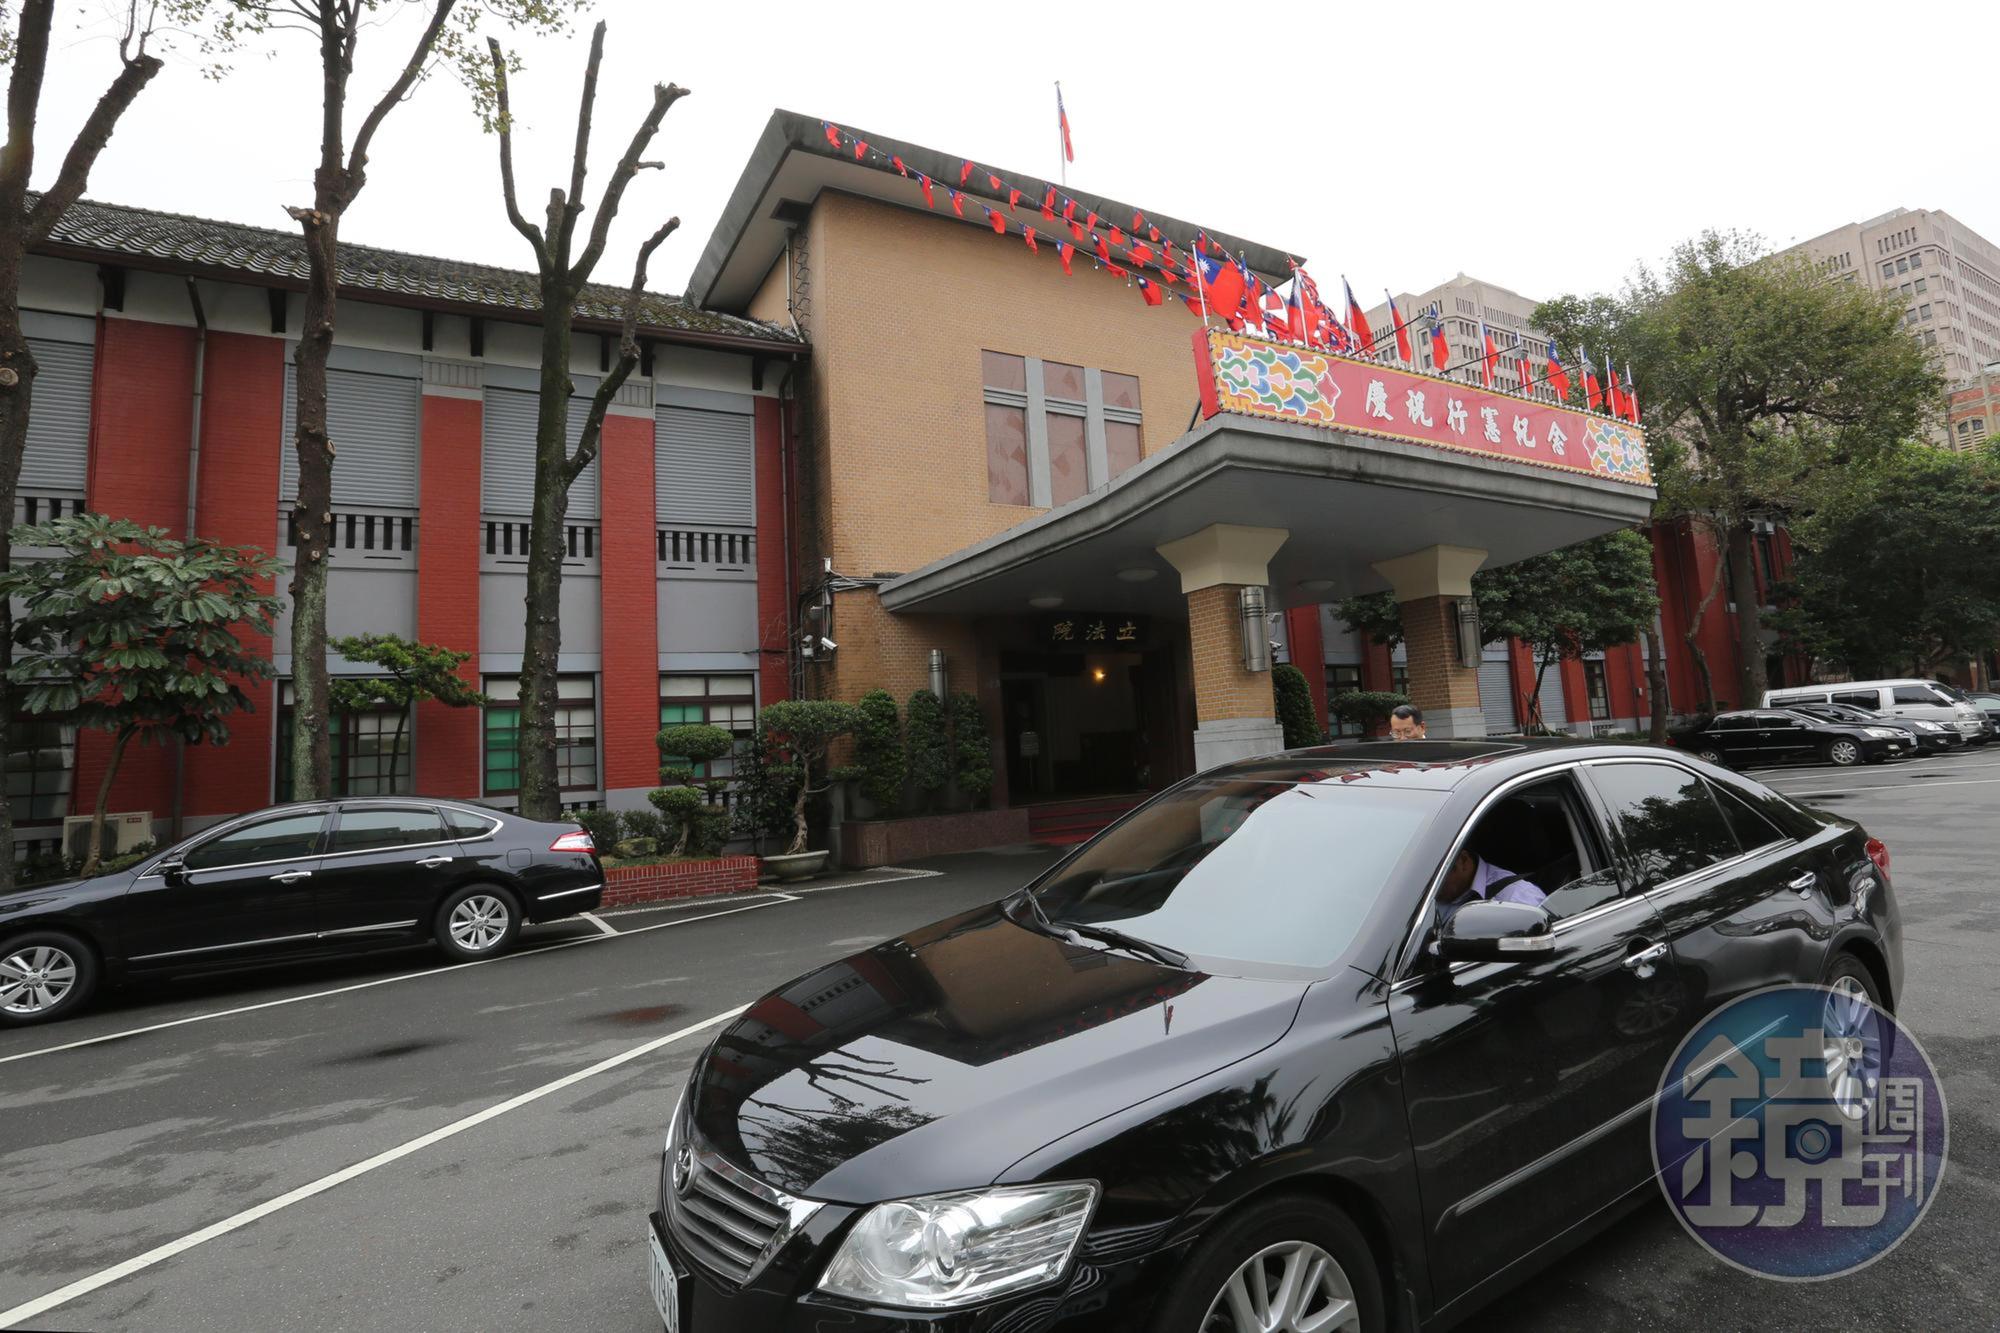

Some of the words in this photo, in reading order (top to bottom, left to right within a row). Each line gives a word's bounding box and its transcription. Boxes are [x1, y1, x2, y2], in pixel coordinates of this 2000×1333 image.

[1365, 379, 1568, 456] 慶祝行憲紀念
[1051, 620, 1137, 641] 立法院
